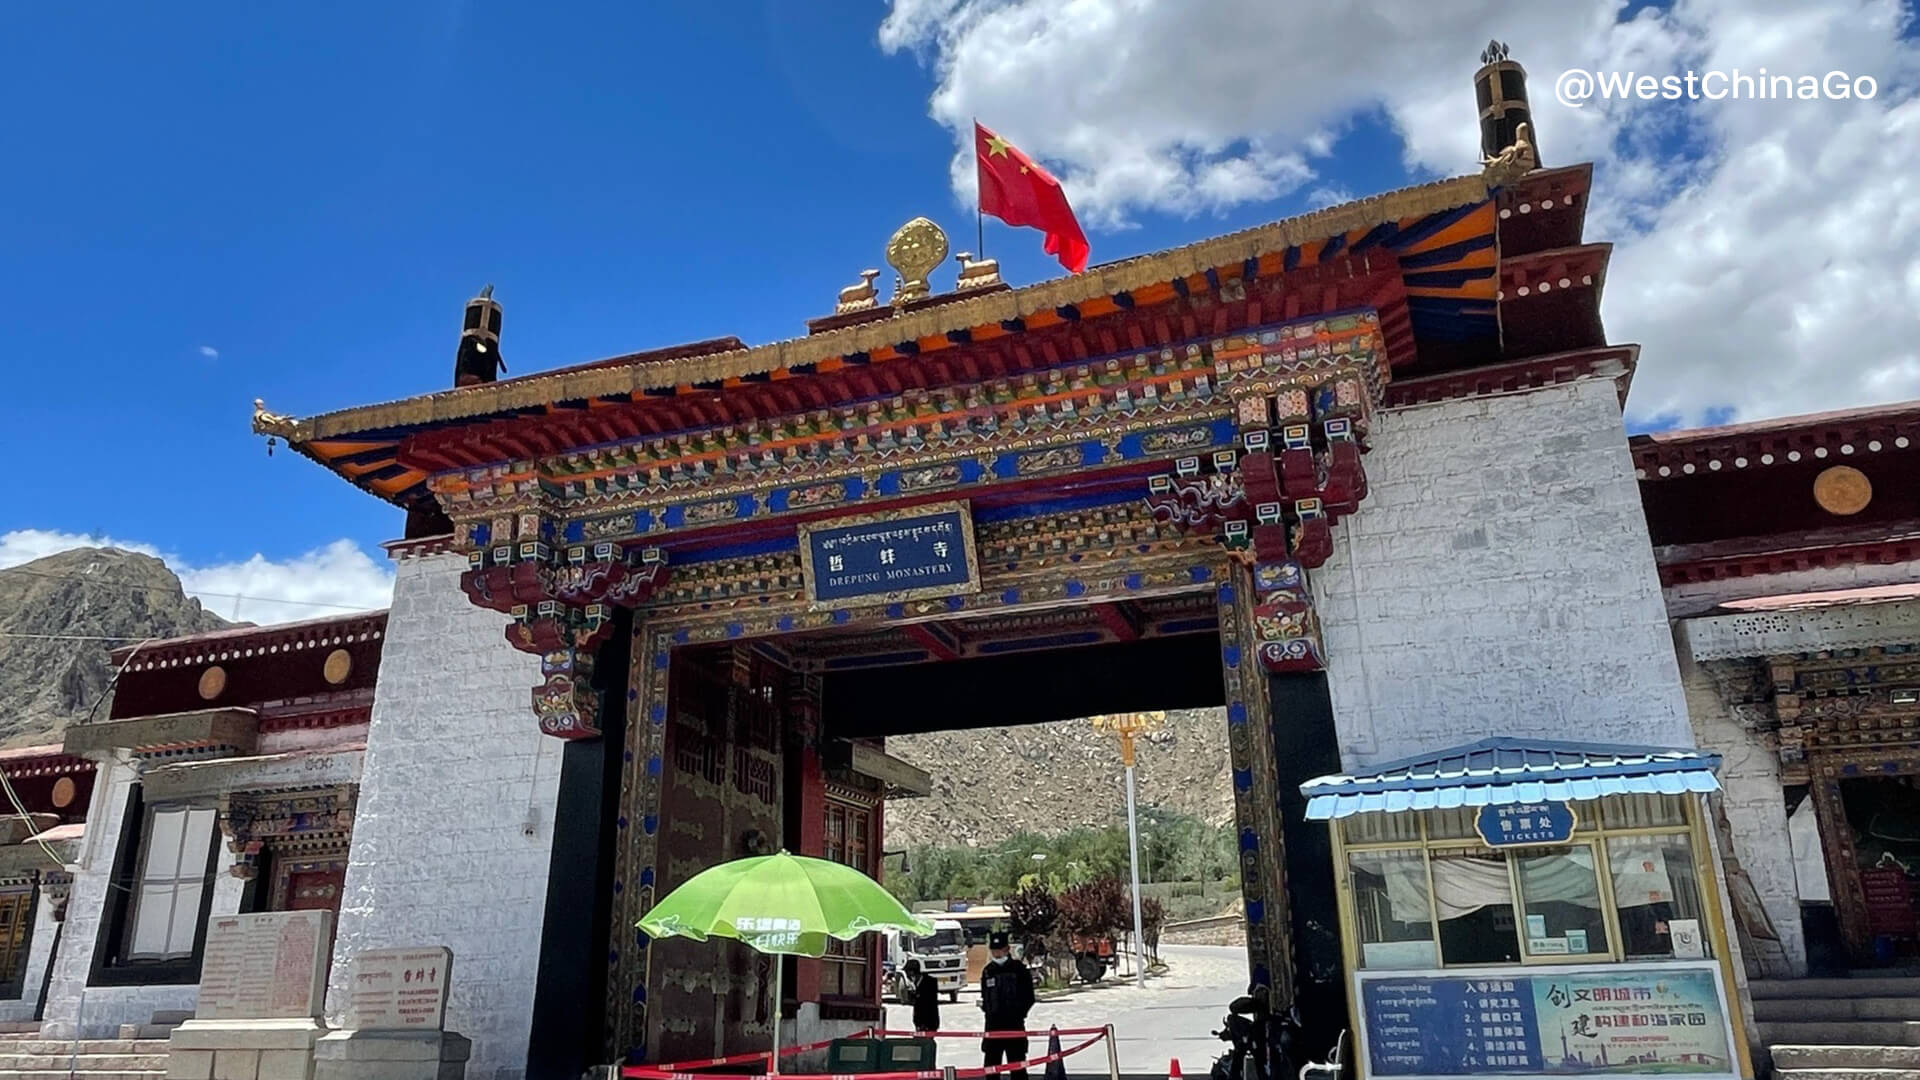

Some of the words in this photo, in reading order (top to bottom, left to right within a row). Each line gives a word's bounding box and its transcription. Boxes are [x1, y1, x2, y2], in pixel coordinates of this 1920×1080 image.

[828, 541, 949, 572] 哲蚌寺
[829, 572, 880, 587] DREPUNG
[886, 563, 953, 580] MONASTERY
[1500, 816, 1553, 832] 售票处
[1504, 832, 1554, 840] TICKETS
